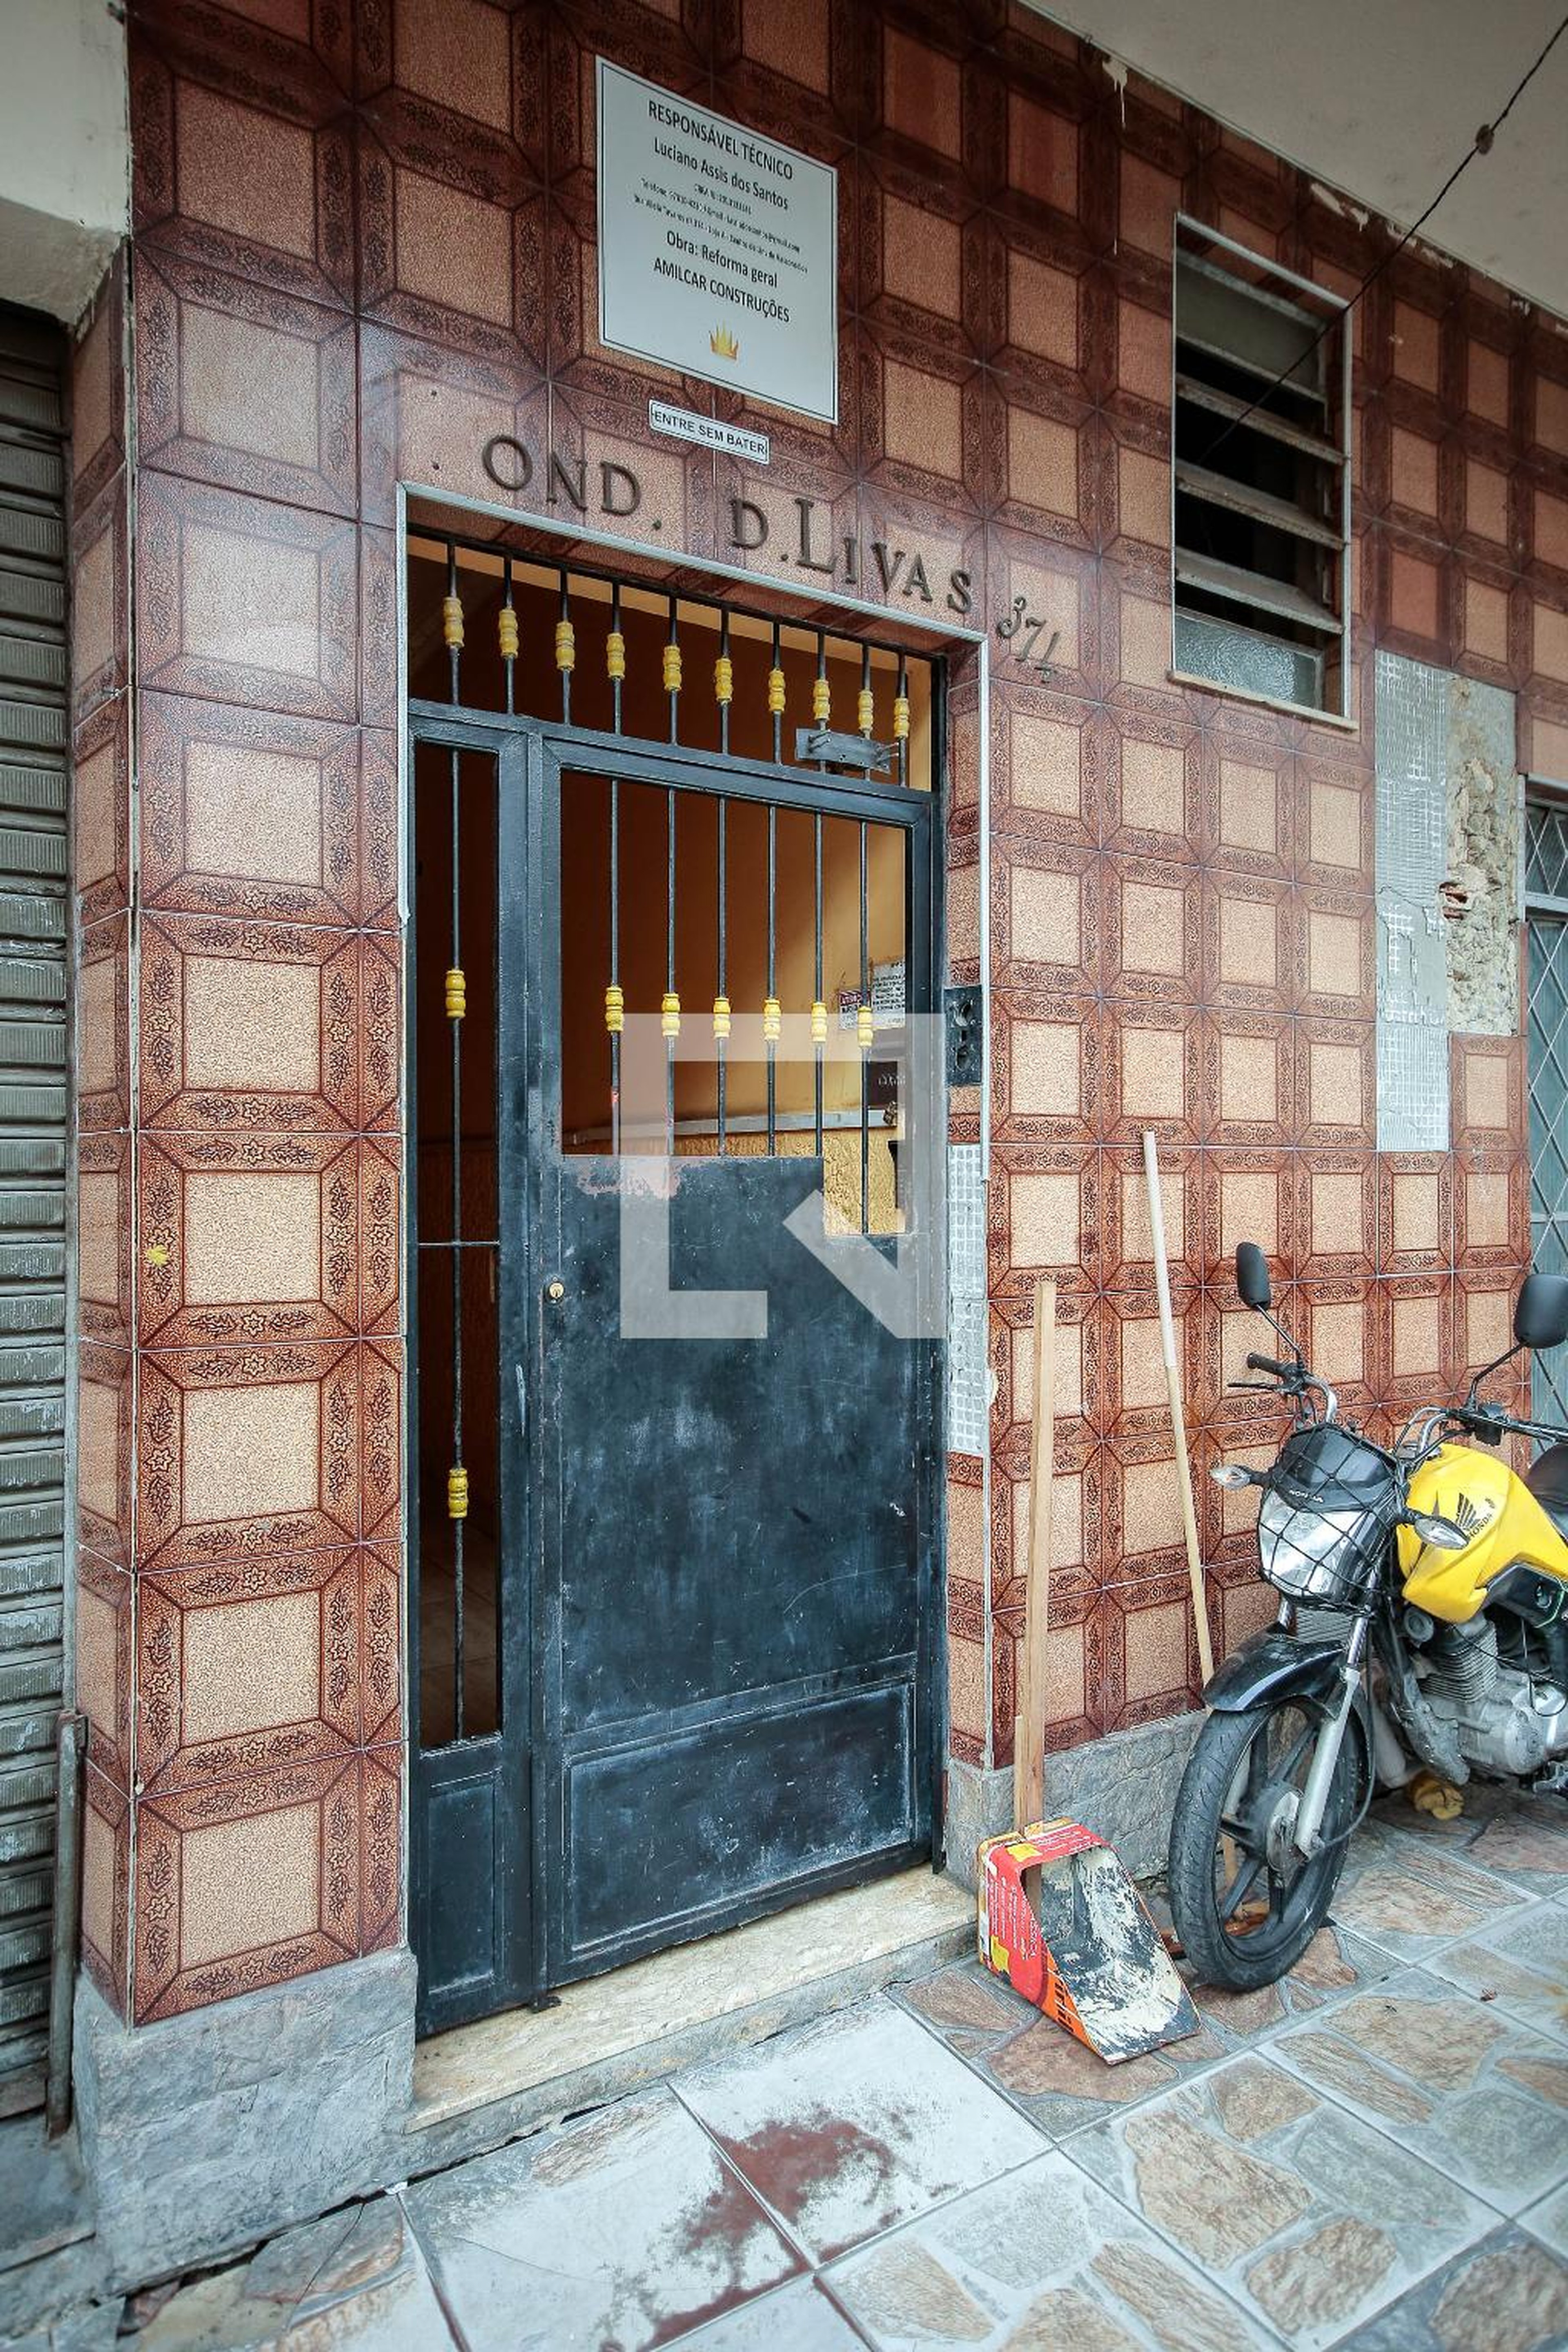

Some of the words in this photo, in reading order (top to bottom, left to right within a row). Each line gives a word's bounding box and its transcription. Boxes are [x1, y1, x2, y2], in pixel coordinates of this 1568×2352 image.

[648, 100, 738, 156] RESPONSÁVEL
[741, 143, 793, 180] TÉCNICO
[654, 136, 697, 170] Luciano
[701, 159, 728, 183] Assis
[731, 172, 750, 193] dos
[753, 182, 788, 210] Santos
[653, 257, 707, 291] AMILCAR
[710, 279, 790, 323] CONSTRUÇÕES
[667, 230, 698, 255] Obra:
[702, 244, 748, 276] Reforma
[751, 268, 777, 288] geral
[654, 411, 695, 432] ENTRE
[698, 425, 723, 441] SEM
[727, 433, 765, 454] BATER
